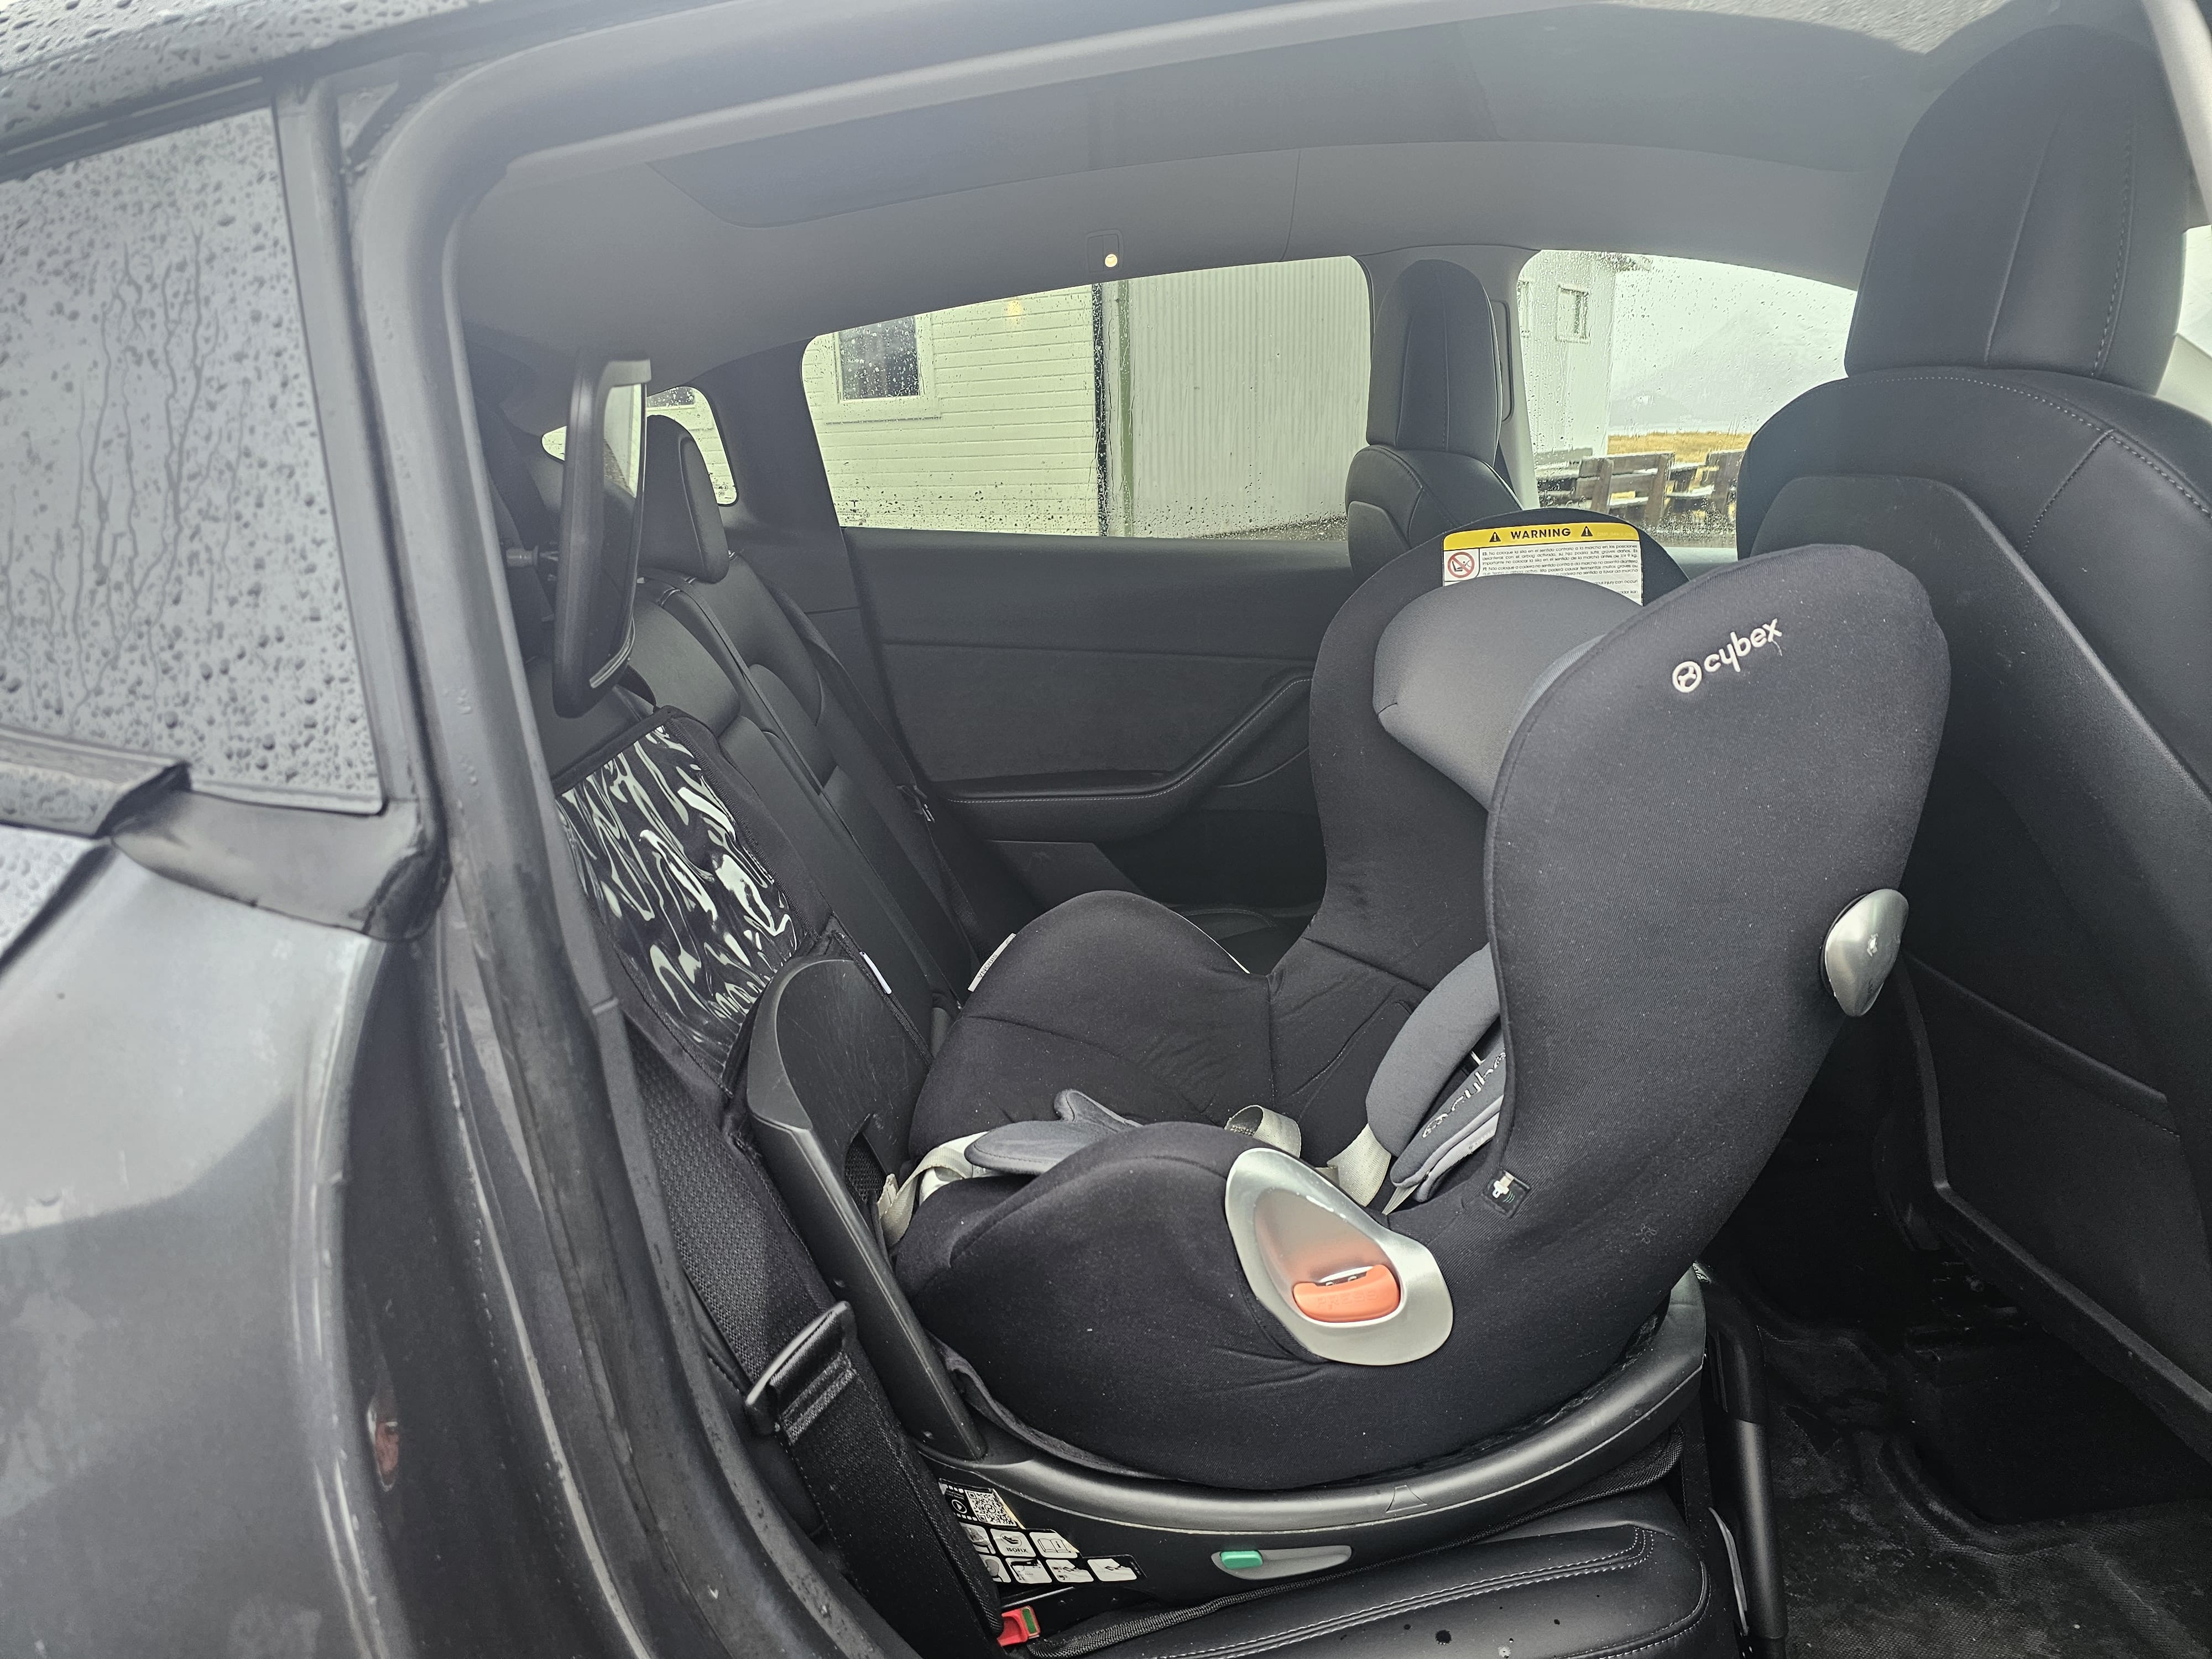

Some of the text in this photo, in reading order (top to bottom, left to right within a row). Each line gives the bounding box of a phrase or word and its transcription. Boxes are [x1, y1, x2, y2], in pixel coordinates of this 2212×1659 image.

[1510, 528, 1571, 540] WARNING
[1704, 618, 1782, 672] cybex
[977, 954, 998, 978] SIRONA
[1317, 1290, 1378, 1309] PRESS
